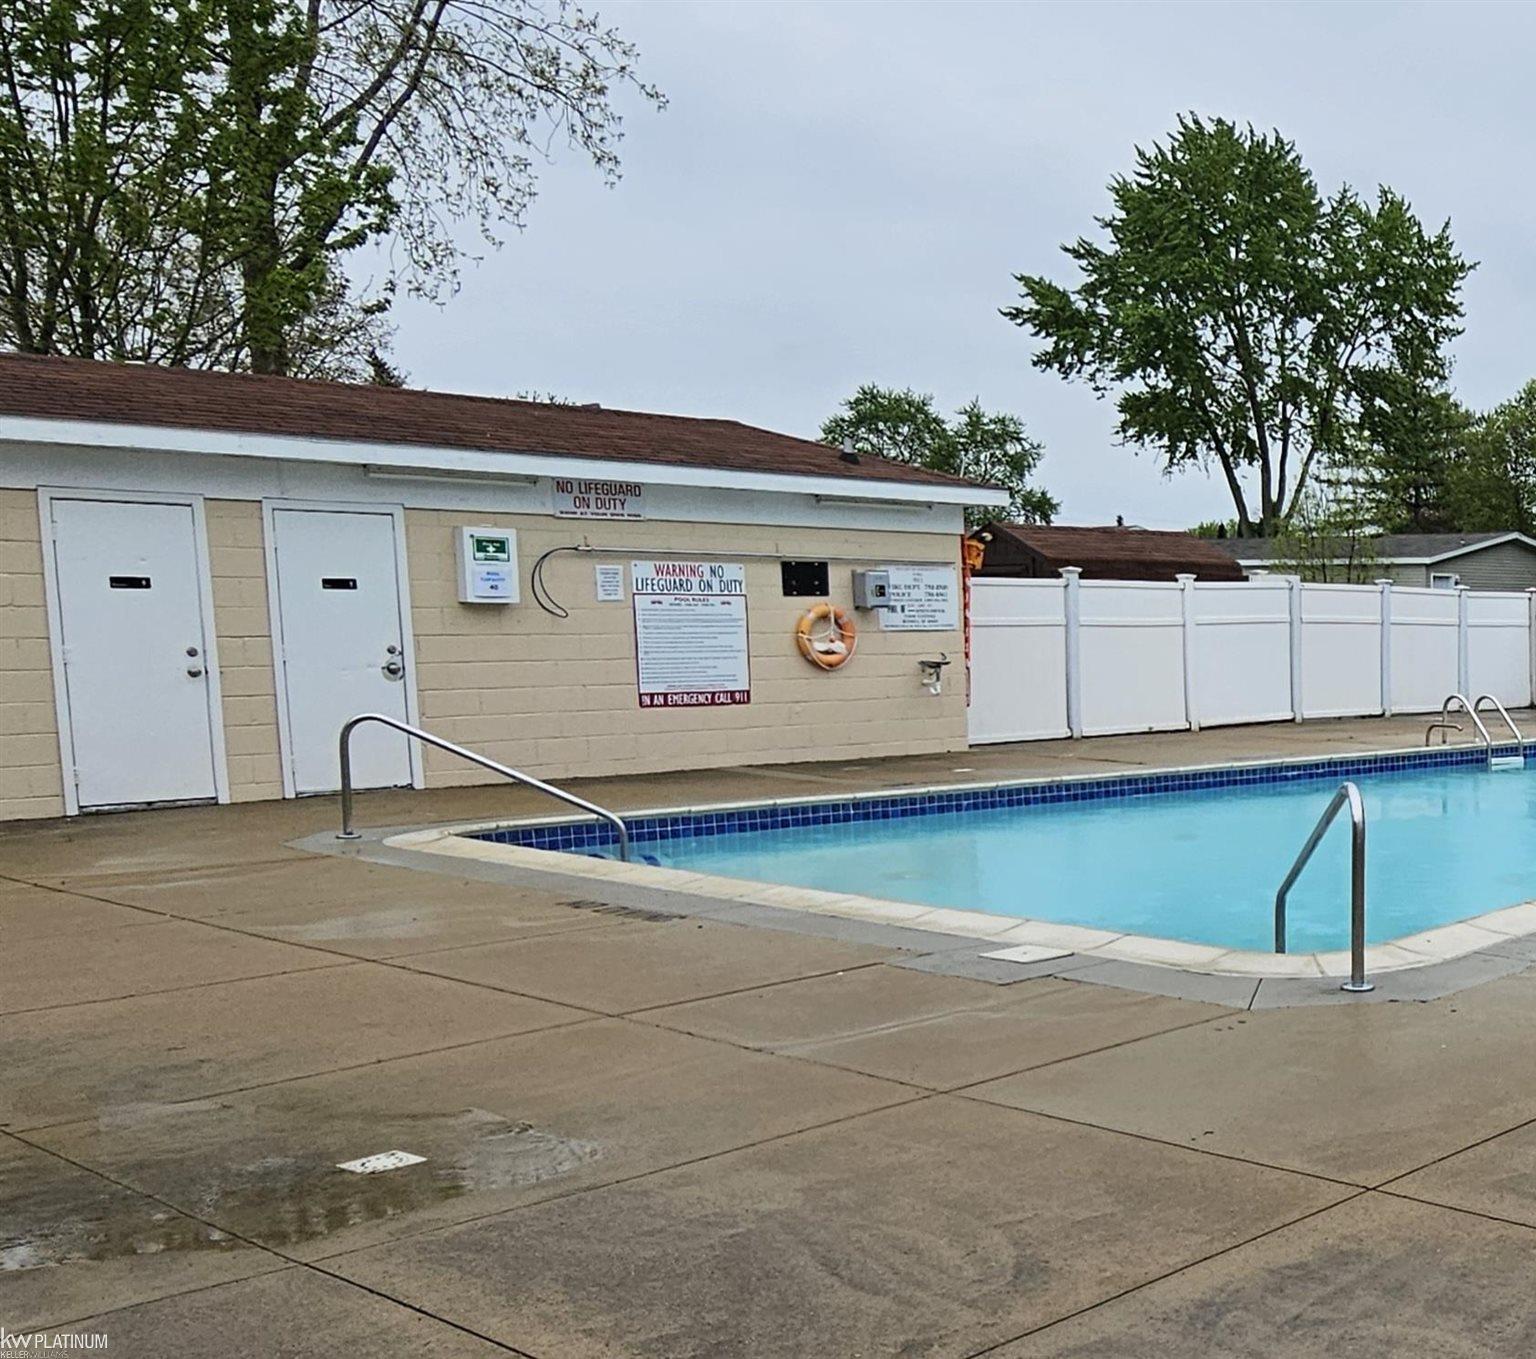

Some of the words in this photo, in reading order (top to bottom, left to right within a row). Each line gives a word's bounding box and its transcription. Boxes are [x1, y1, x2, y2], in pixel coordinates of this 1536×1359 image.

[556, 480, 573, 494] NO
[578, 482, 642, 497] LIFEGUARD
[573, 495, 590, 509] ON
[595, 497, 627, 510] DUTY
[654, 563, 704, 578] WARNING
[710, 565, 724, 579] NO
[635, 577, 693, 592] LIFEGUARD
[698, 579, 713, 592] ON
[719, 580, 743, 593] DUTY
[641, 694, 651, 706] IN
[653, 694, 665, 706] AN
[667, 692, 712, 705] EMERGENCY
[715, 692, 732, 703] CALL
[734, 692, 748, 703] 911
